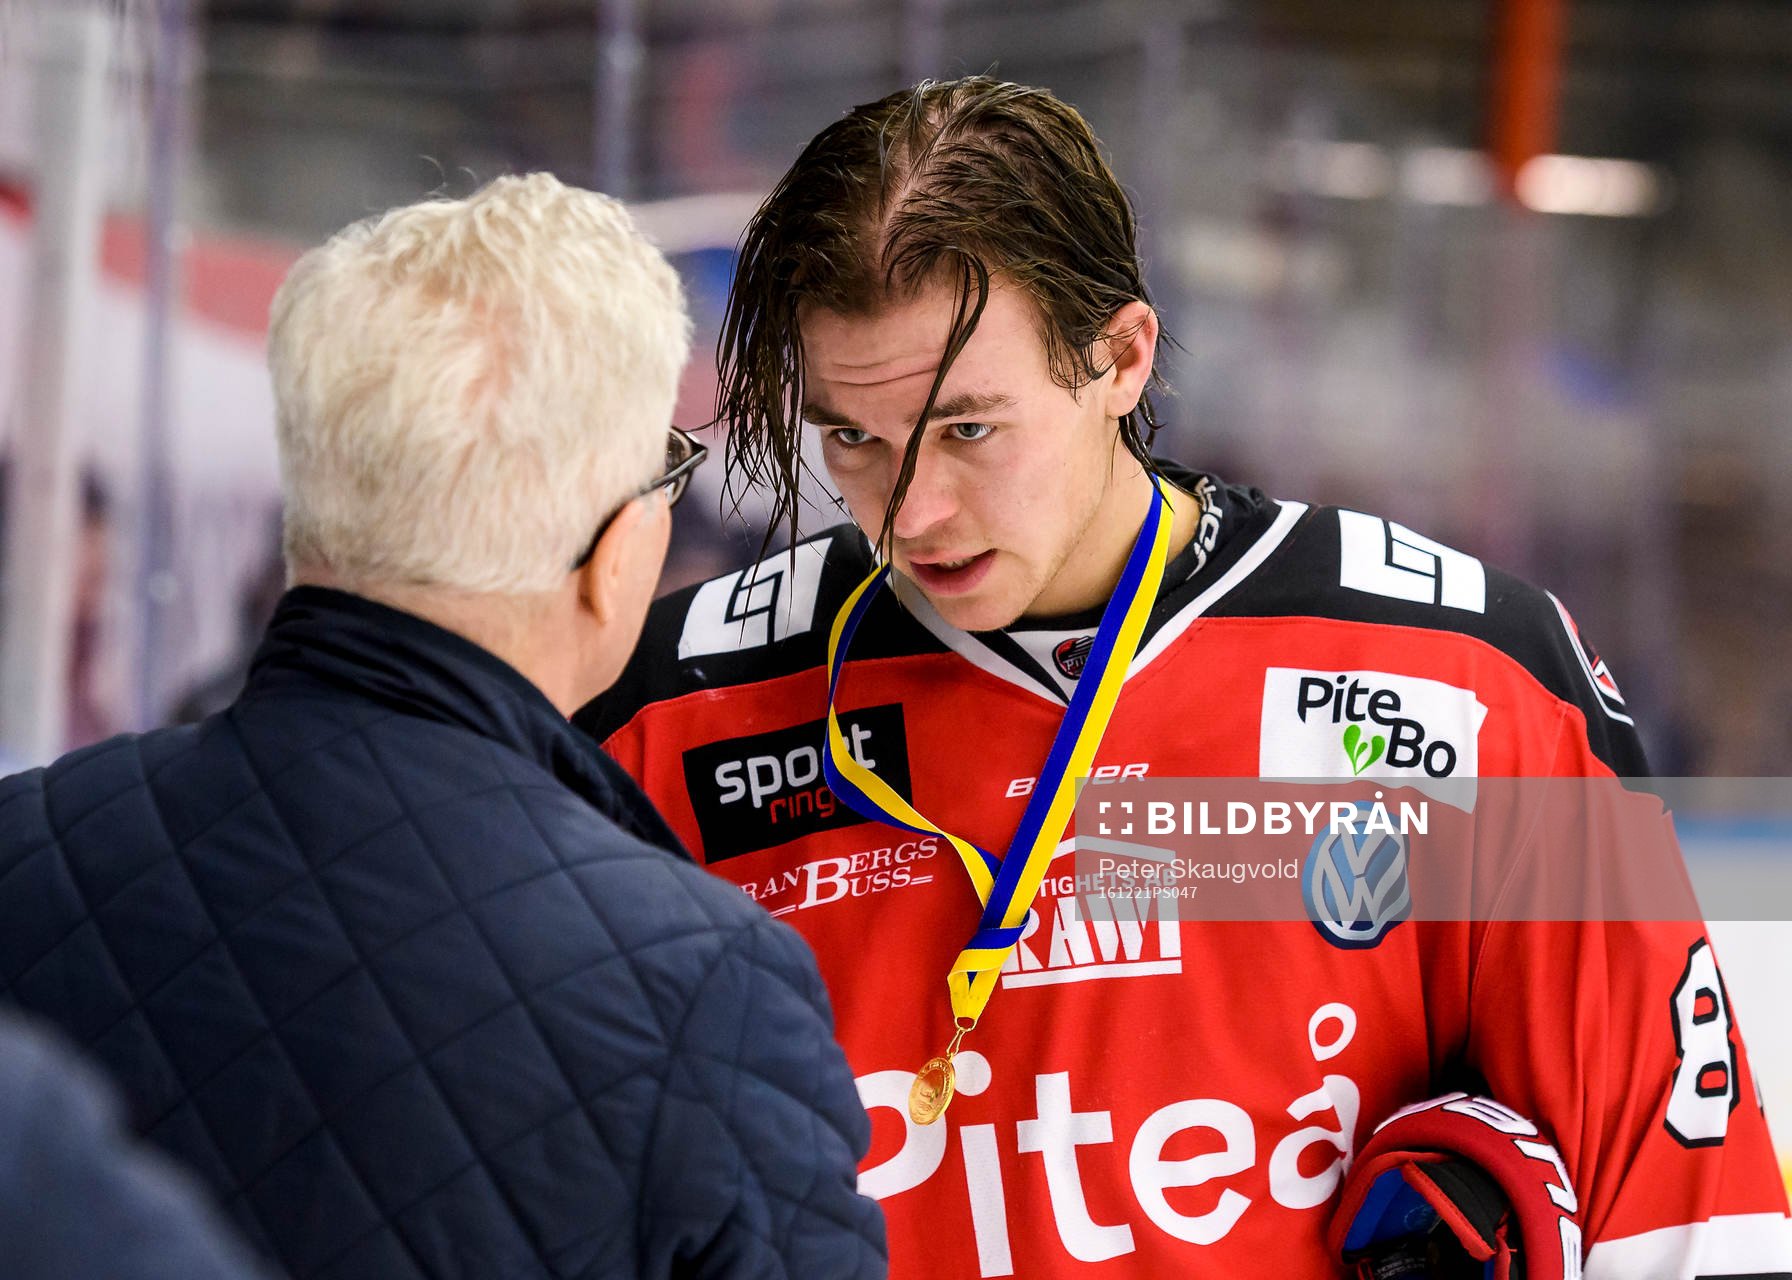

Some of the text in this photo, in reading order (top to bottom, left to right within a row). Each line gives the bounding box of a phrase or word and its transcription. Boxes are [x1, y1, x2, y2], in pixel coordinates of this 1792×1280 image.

[715, 723, 876, 808] spot
[1005, 763, 1150, 798] BER
[769, 786, 846, 825] ring
[738, 837, 939, 910] RANBERGS
[1038, 869, 1136, 897] TIGHETS
[1664, 936, 1764, 1149] 8
